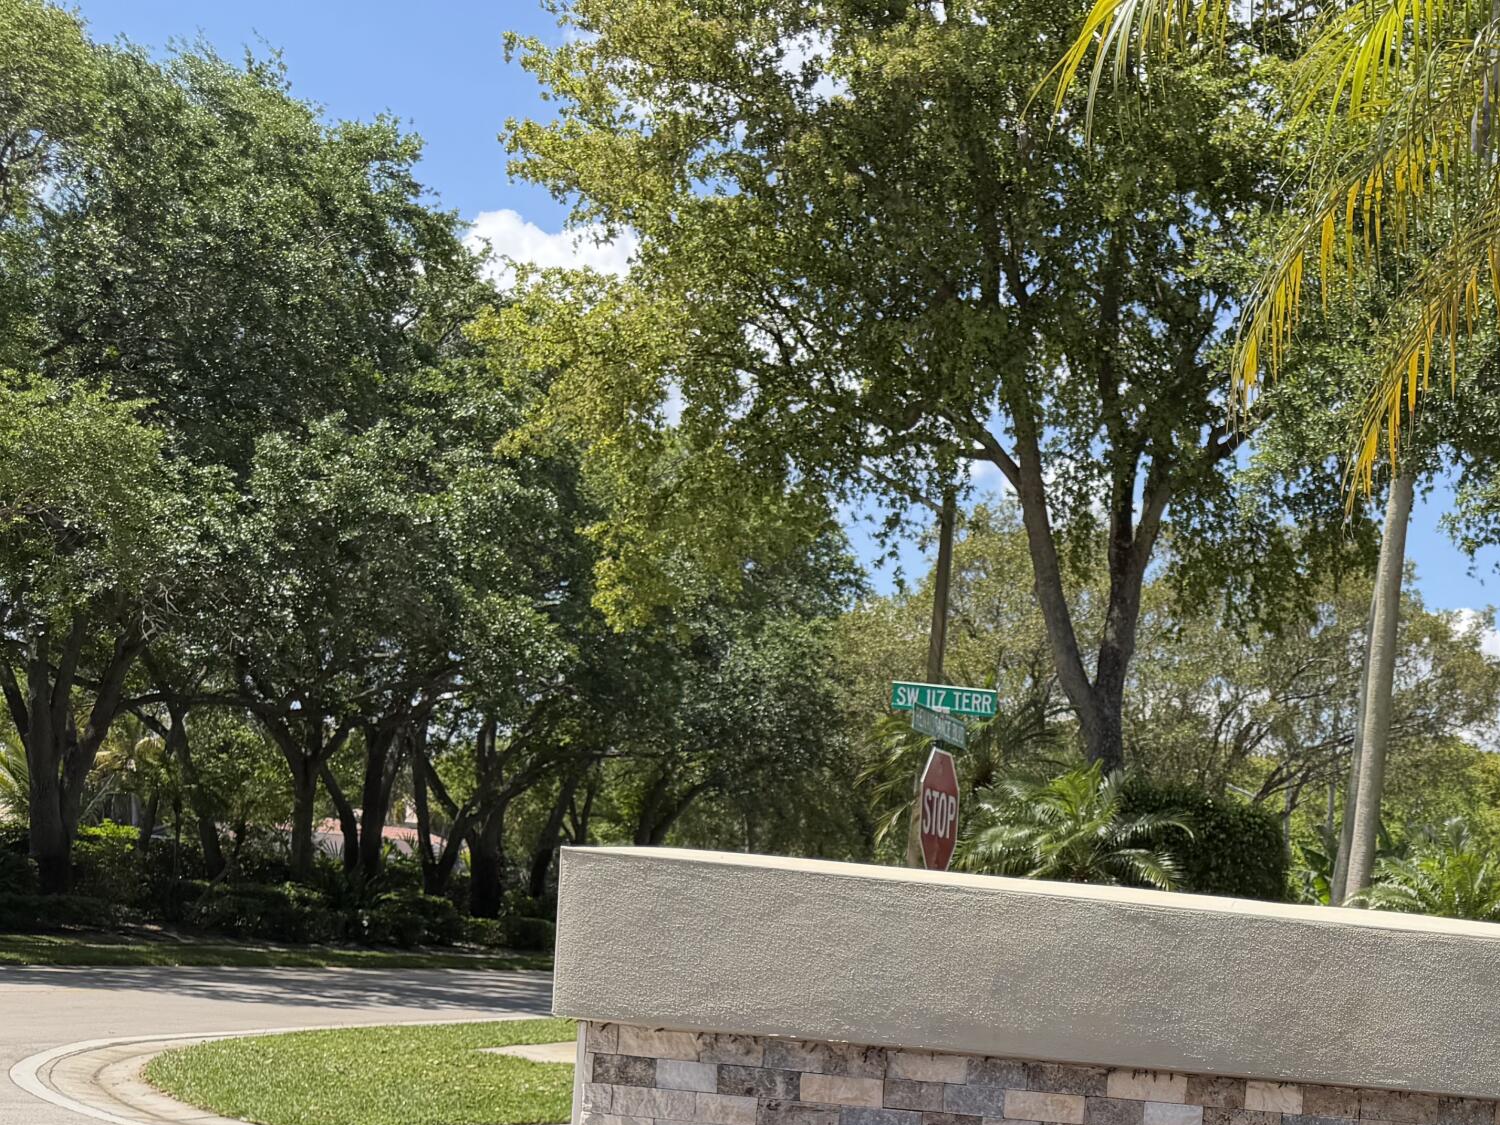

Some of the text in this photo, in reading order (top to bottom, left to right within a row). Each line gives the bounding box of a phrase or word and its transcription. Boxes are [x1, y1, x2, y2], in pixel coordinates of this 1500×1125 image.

[897, 686, 992, 713] SW 117 TERR
[923, 789, 956, 839] STOP
